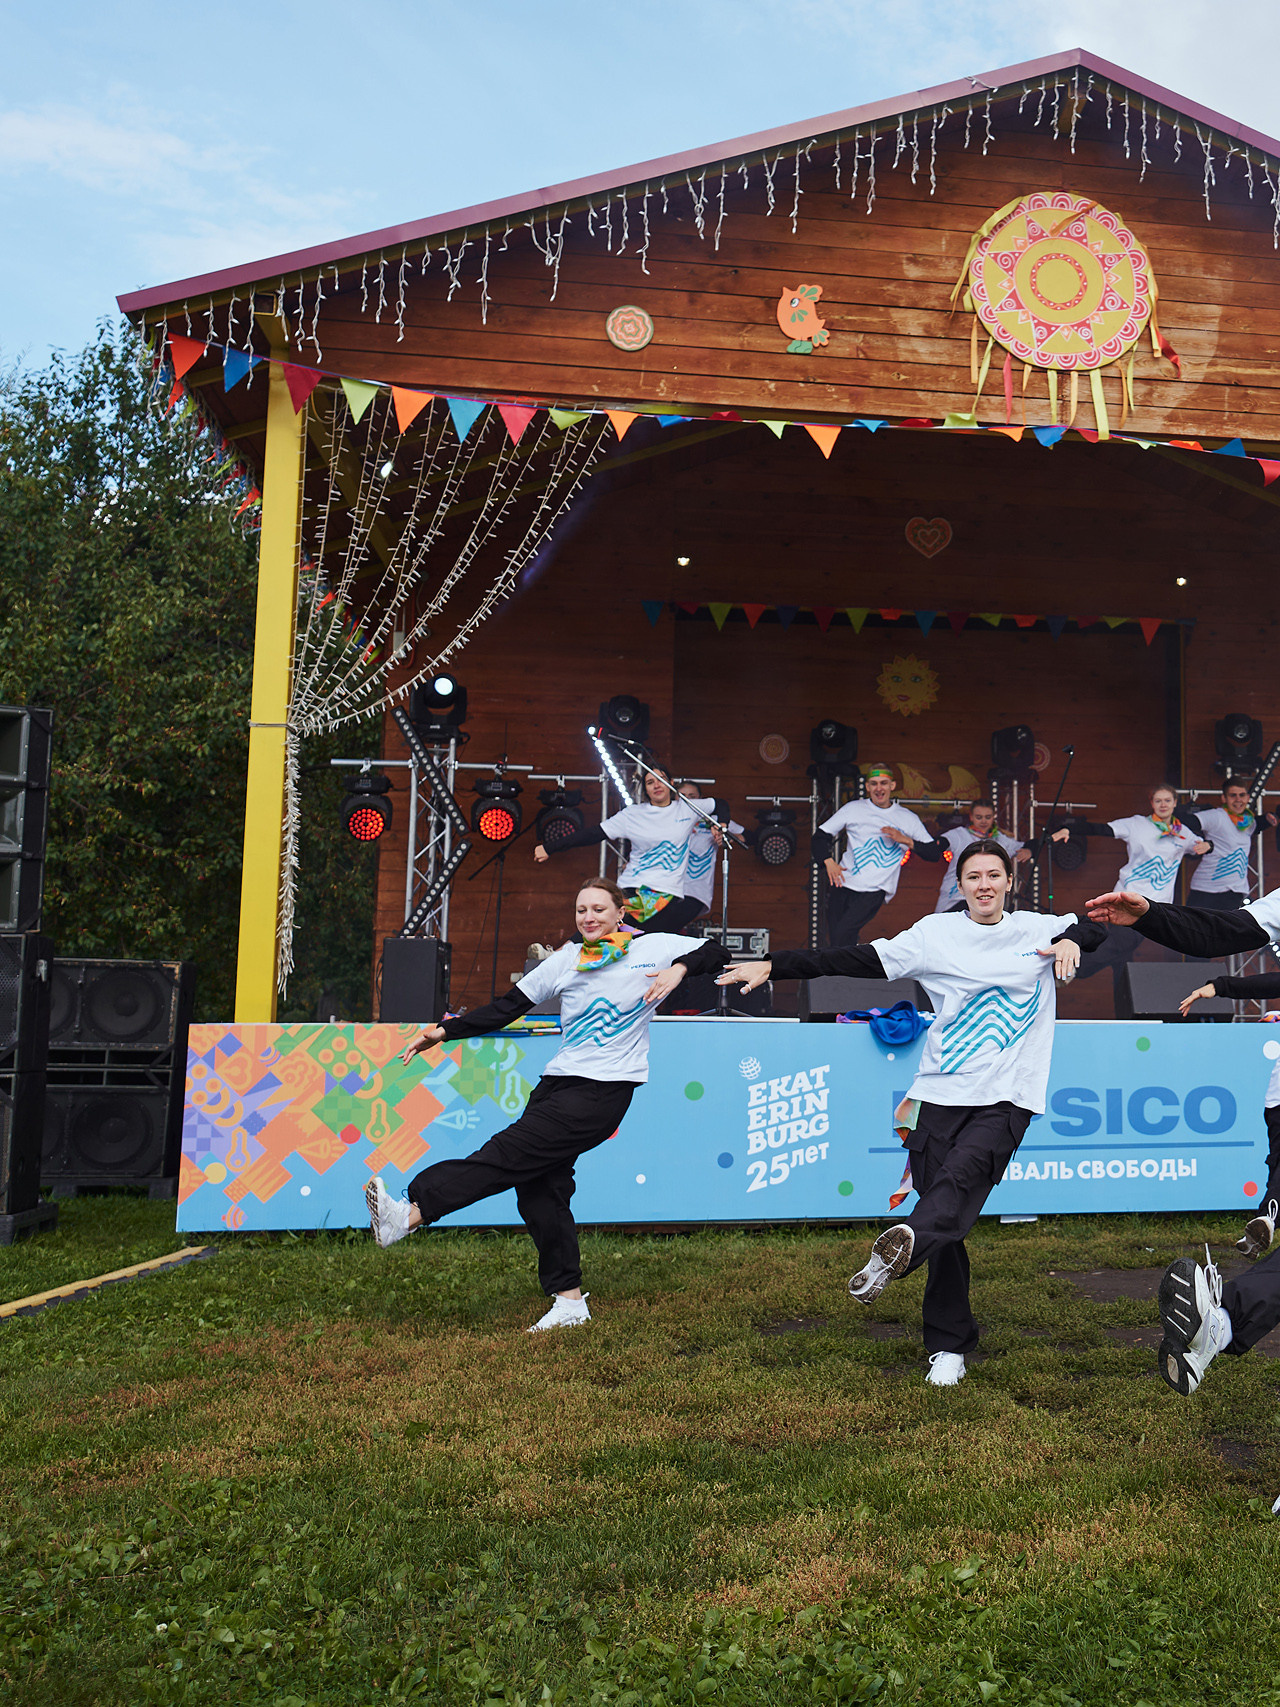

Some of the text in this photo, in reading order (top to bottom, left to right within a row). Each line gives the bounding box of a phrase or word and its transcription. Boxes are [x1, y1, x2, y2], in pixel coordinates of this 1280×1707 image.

[748, 1064, 830, 1107] EKAT
[747, 1088, 829, 1131] ERIN
[747, 1113, 829, 1155] BURG
[1077, 1159, 1197, 1181] СВОБОДЫ
